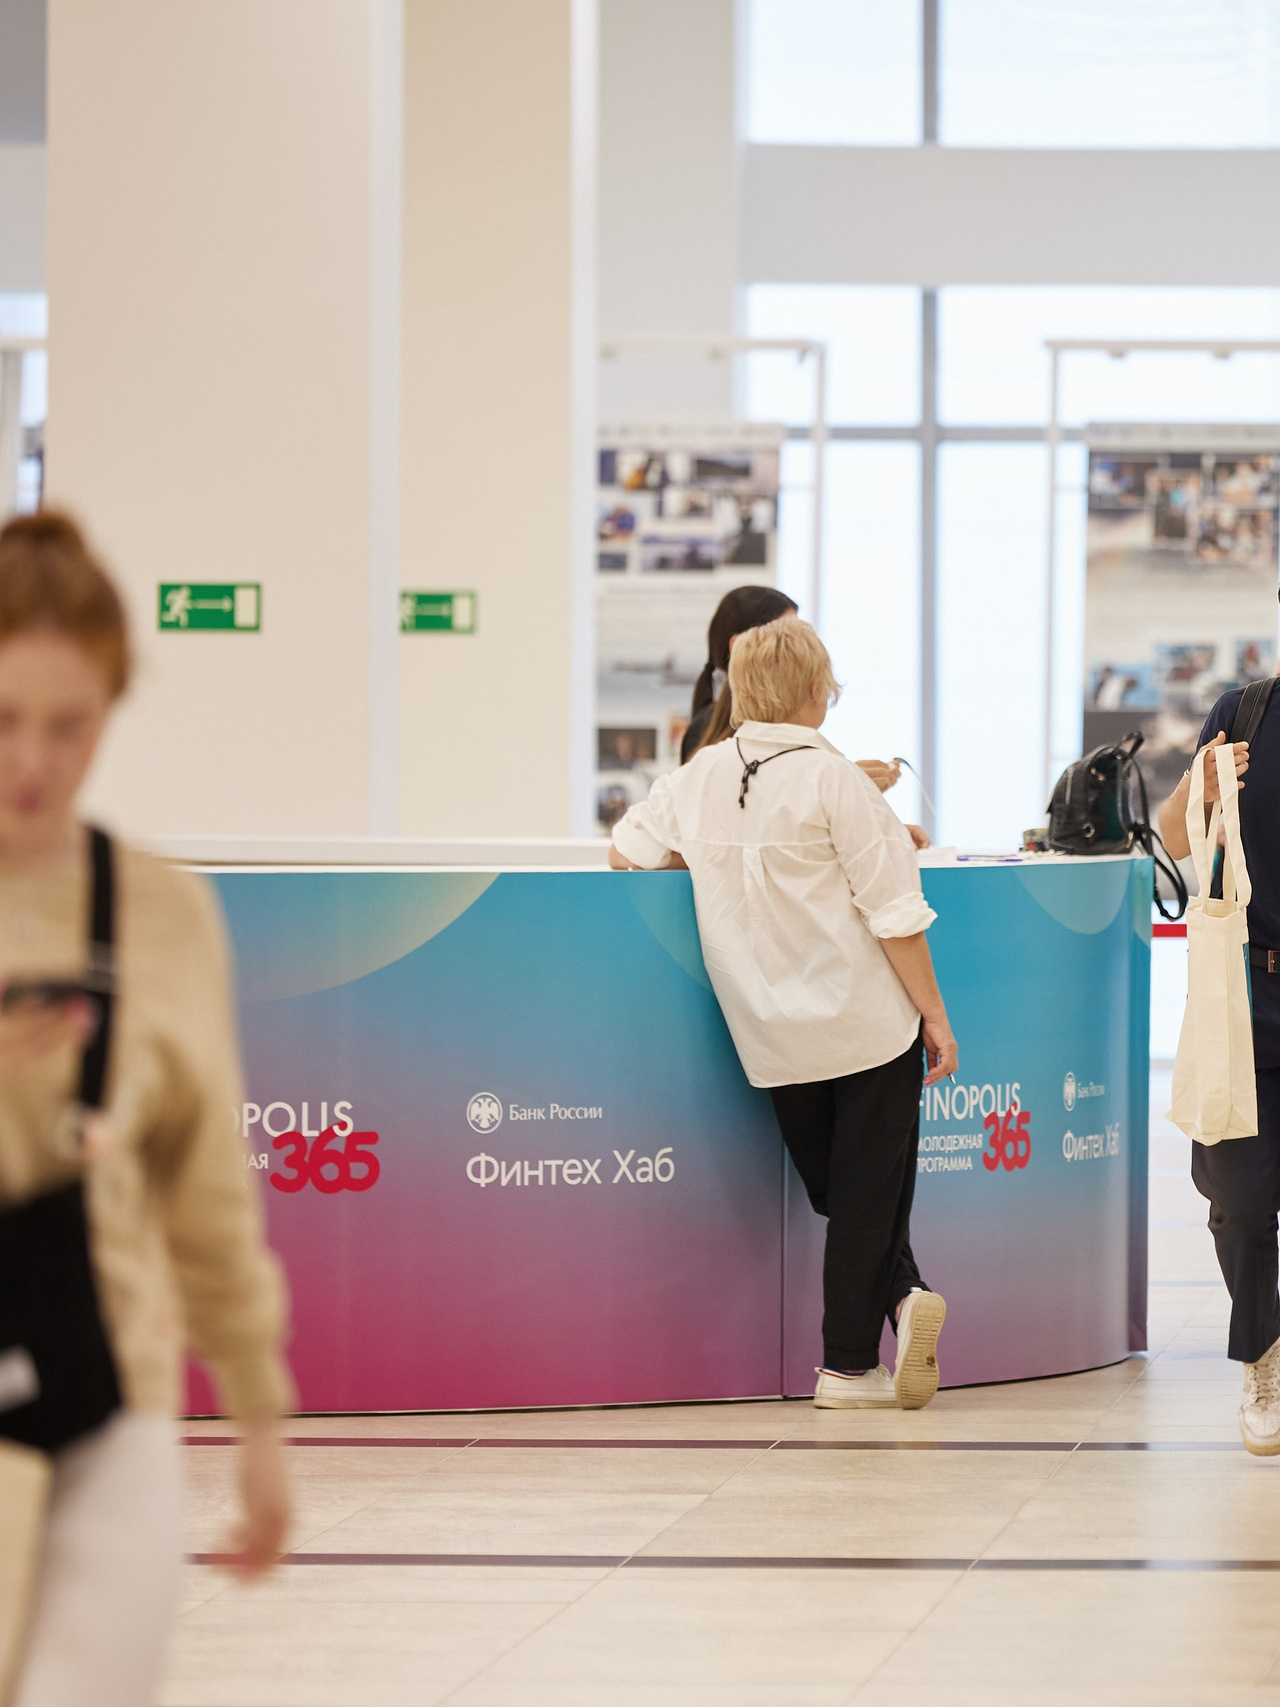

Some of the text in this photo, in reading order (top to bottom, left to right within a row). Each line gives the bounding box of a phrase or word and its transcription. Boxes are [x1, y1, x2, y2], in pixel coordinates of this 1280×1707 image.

[509, 1103, 603, 1121] Банк России
[982, 1102, 1031, 1172] 365
[270, 1121, 380, 1194] 365
[466, 1147, 675, 1188] Финтех Хаб
